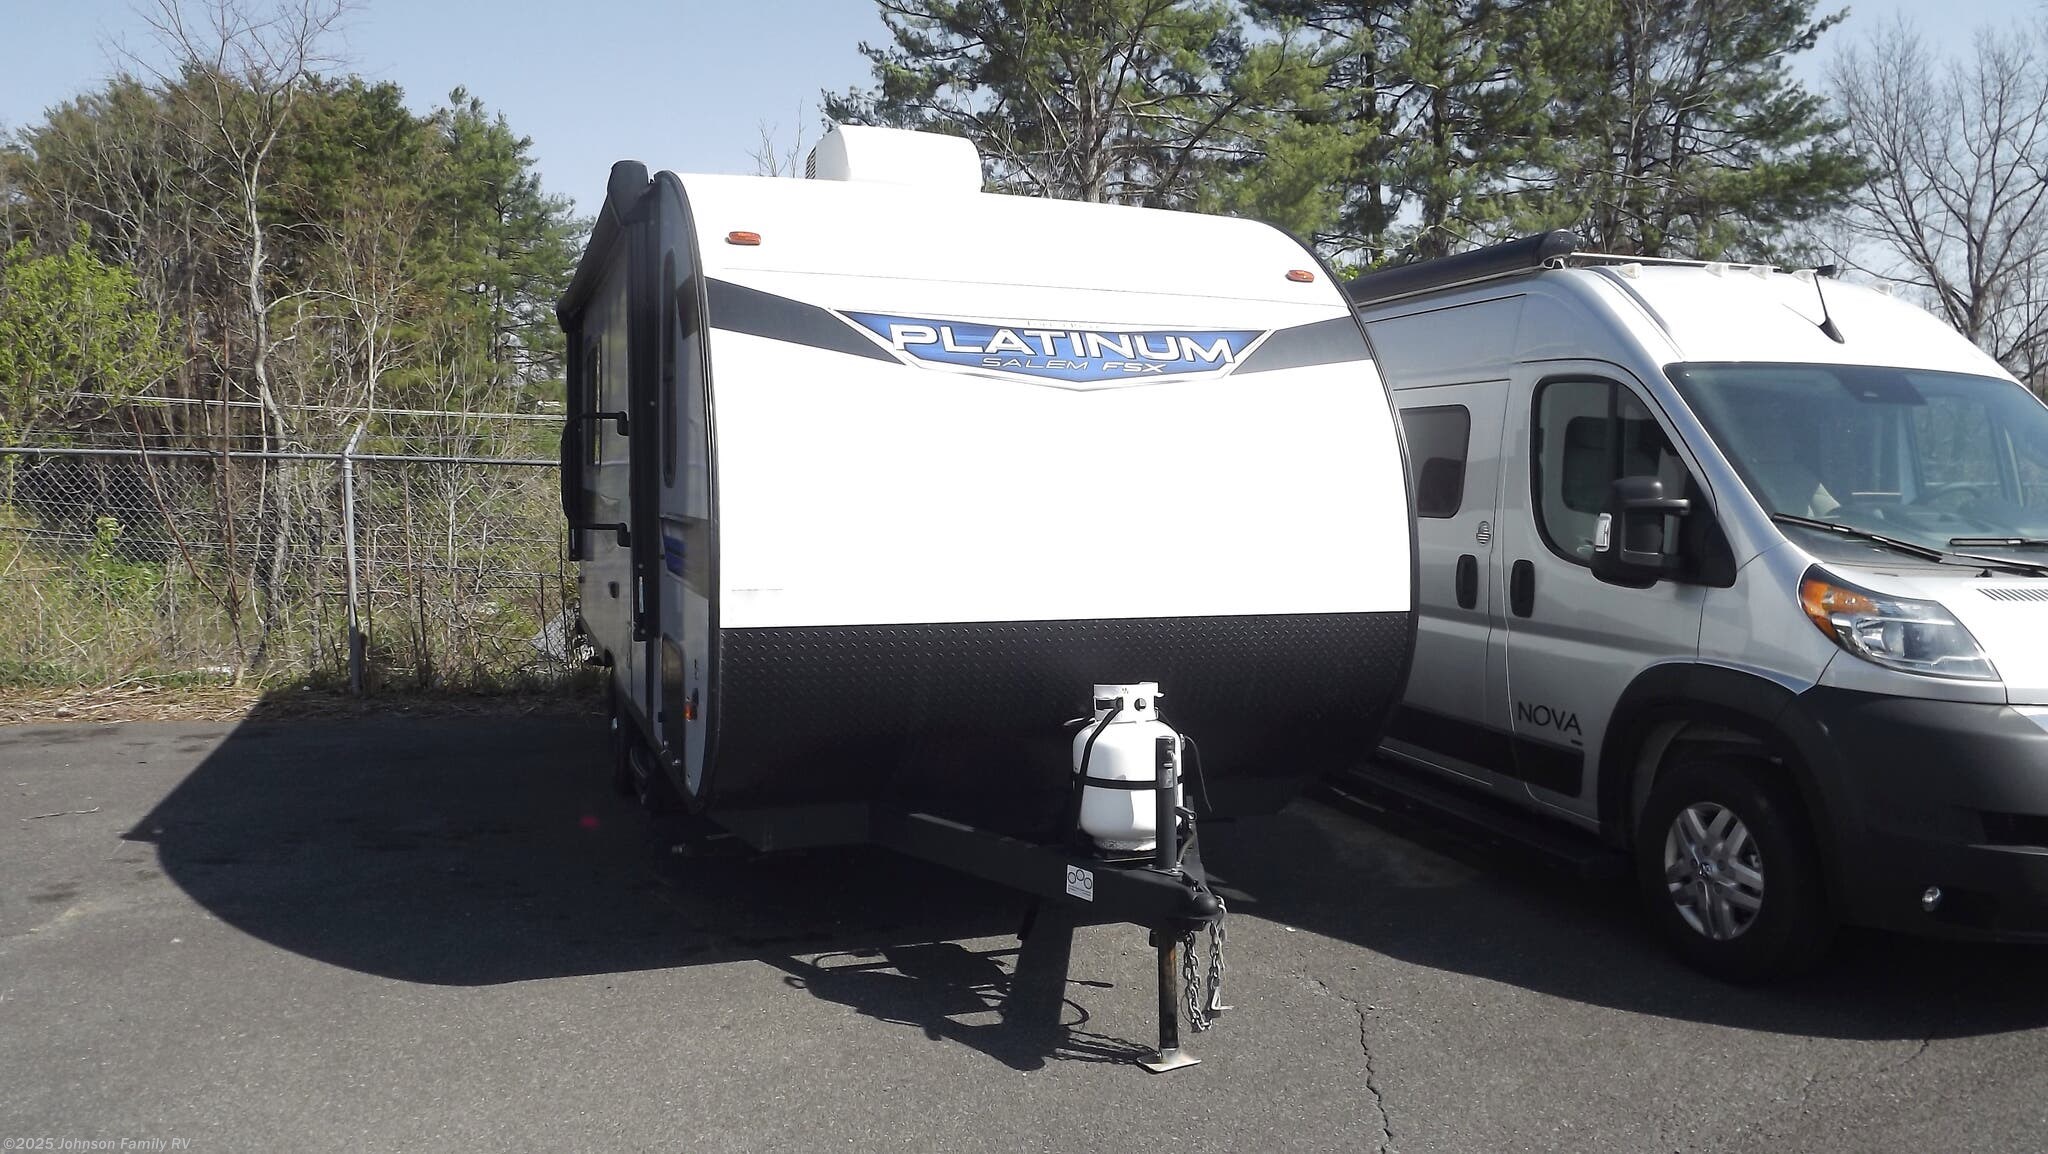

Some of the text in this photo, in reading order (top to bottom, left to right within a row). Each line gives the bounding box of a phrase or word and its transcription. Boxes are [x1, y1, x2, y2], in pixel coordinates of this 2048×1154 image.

[890, 323, 1236, 365] PLATINUM
[982, 357, 1167, 374] SALEM FSX
[1517, 701, 1582, 736] NOVA
